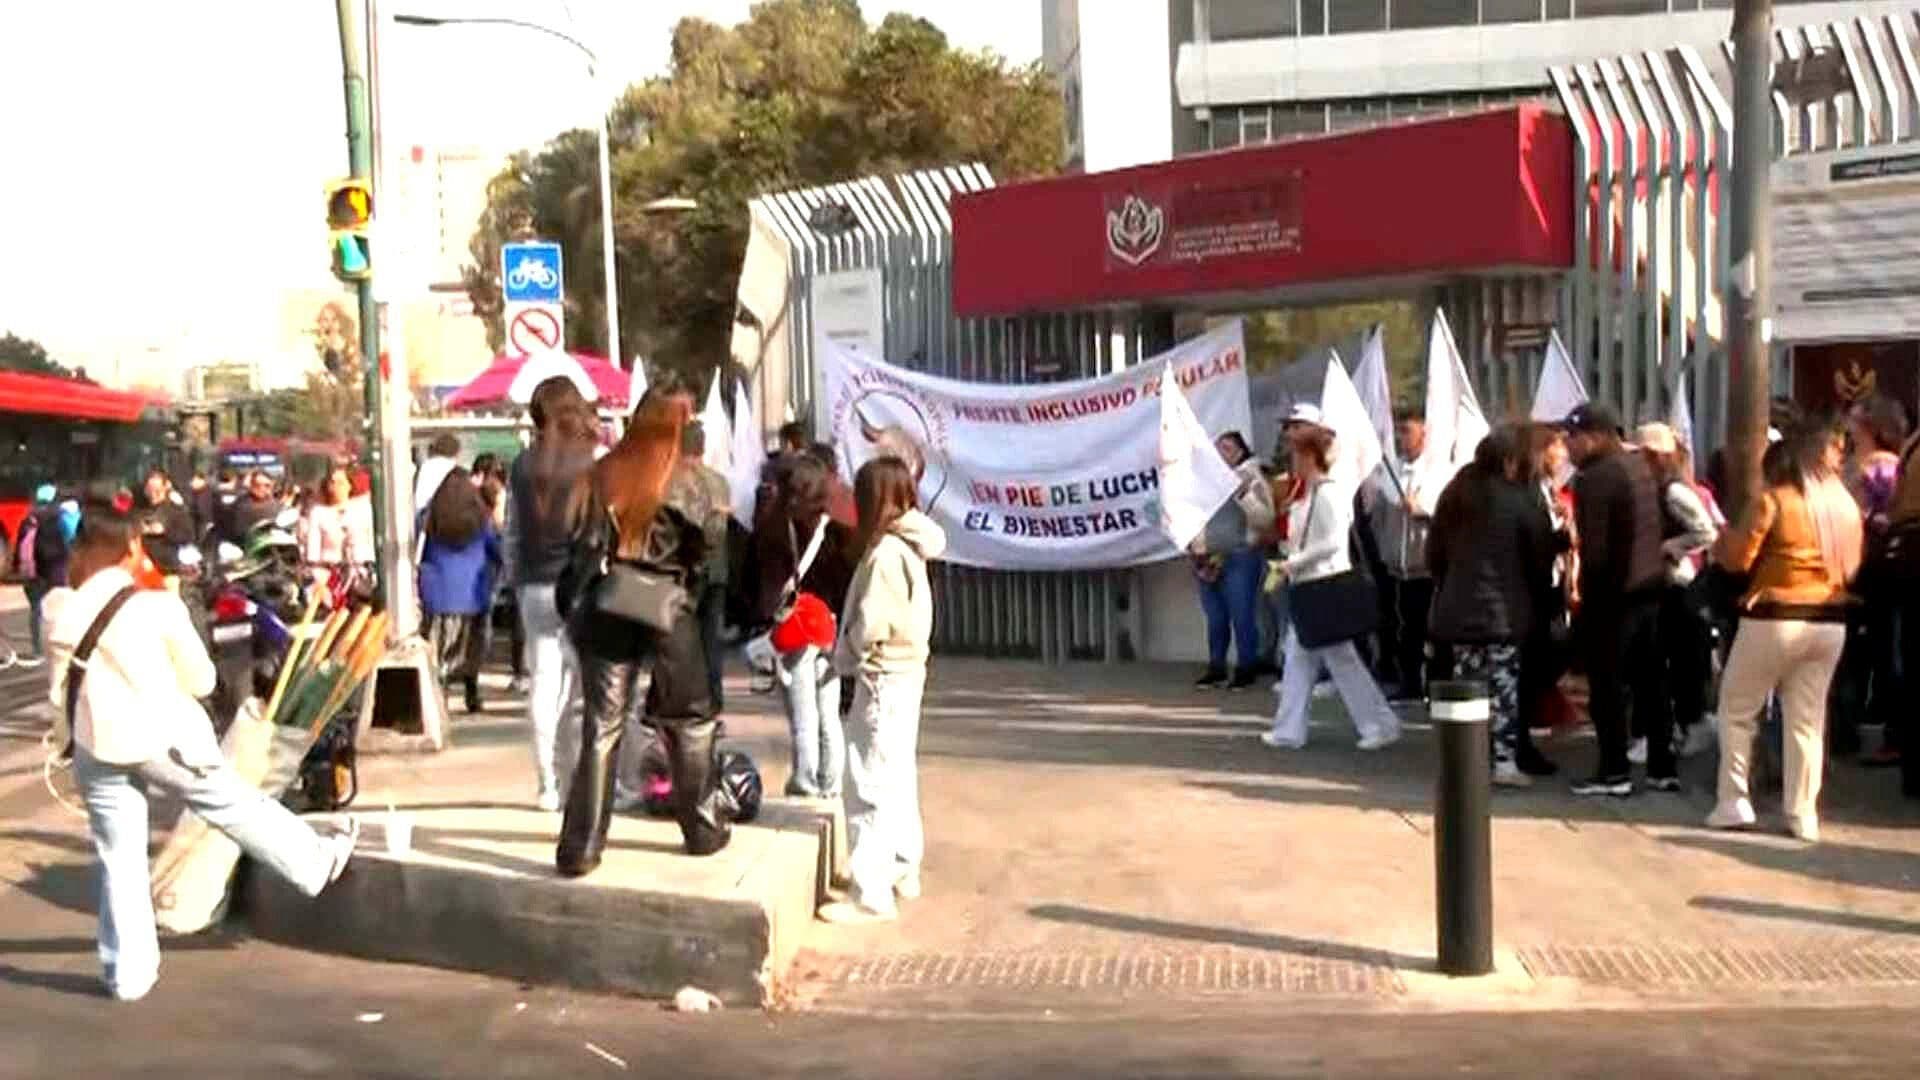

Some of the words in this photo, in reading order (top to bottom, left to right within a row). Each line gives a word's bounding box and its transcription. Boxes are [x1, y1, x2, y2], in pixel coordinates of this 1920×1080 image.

[953, 402, 1022, 425] FRENTE
[1027, 388, 1136, 425] INCLUSIVO
[1142, 349, 1240, 395] POULAR
[1006, 483, 1044, 508] PIE
[1050, 482, 1081, 507] DE
[1088, 466, 1160, 503] LUCH
[964, 510, 994, 531] EL
[1003, 508, 1139, 538] BIENESTAR
